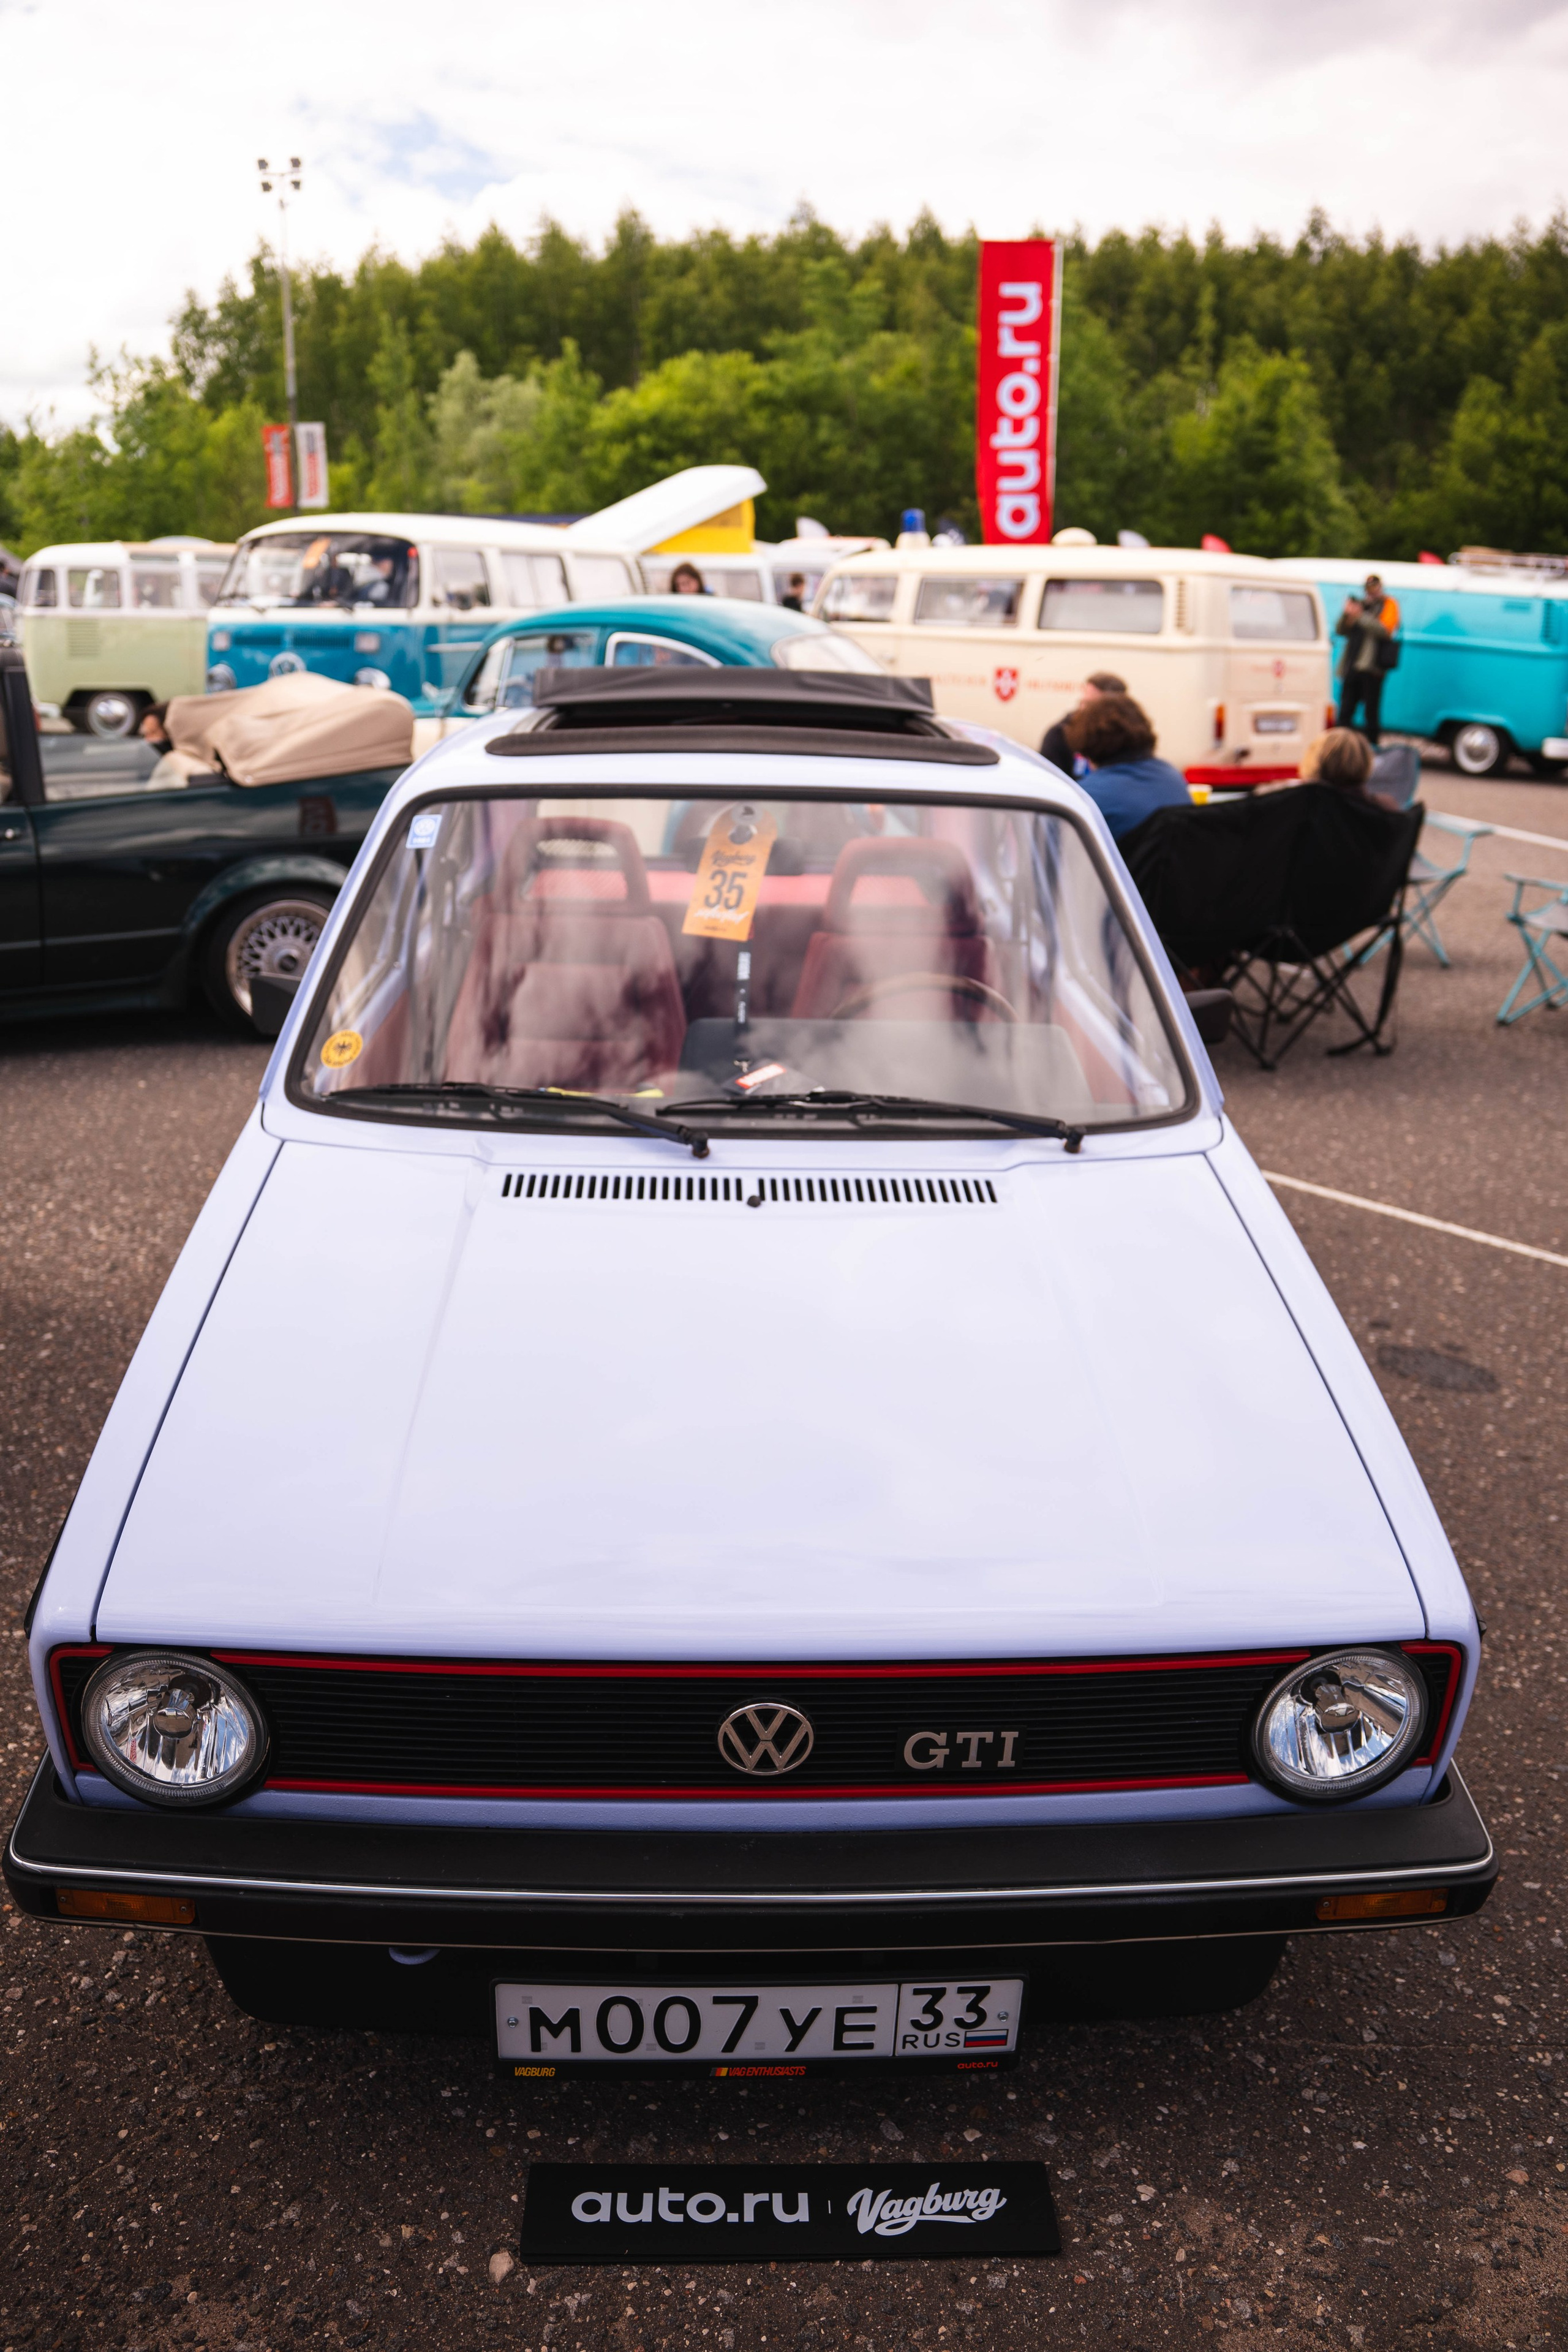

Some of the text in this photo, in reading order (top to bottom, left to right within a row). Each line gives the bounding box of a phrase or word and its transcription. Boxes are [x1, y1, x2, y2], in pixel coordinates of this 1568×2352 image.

[989, 281, 1043, 540] auto.ru
[704, 869, 748, 911] 35
[903, 1731, 1019, 1770] GTI
[910, 1985, 992, 2032] 33
[902, 2031, 962, 2051] RUS
[514, 2067, 556, 2077] VAGBURG
[957, 2061, 999, 2070] auto.ru
[570, 2182, 1008, 2237] auto.ru Vagburg
